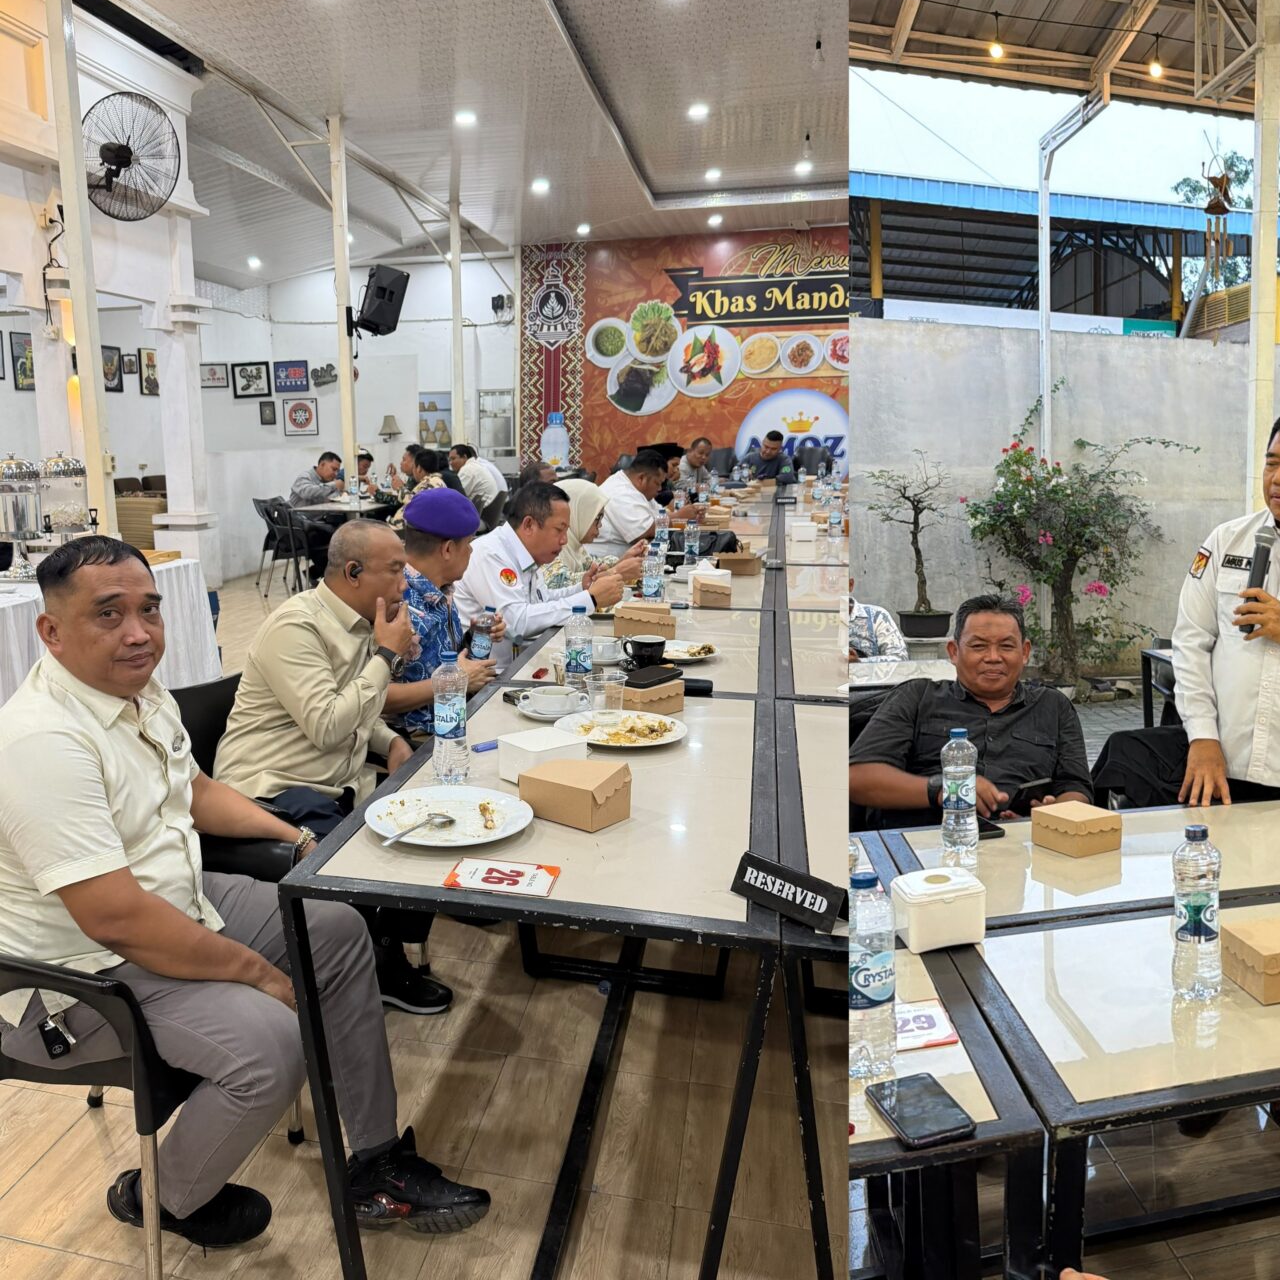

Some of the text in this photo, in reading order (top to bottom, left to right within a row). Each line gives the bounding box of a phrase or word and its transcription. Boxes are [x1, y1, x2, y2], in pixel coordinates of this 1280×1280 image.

[688, 288, 758, 319] Khas
[481, 867, 525, 887] 26
[743, 866, 828, 914] RESERVED
[897, 1013, 937, 1035] 29
